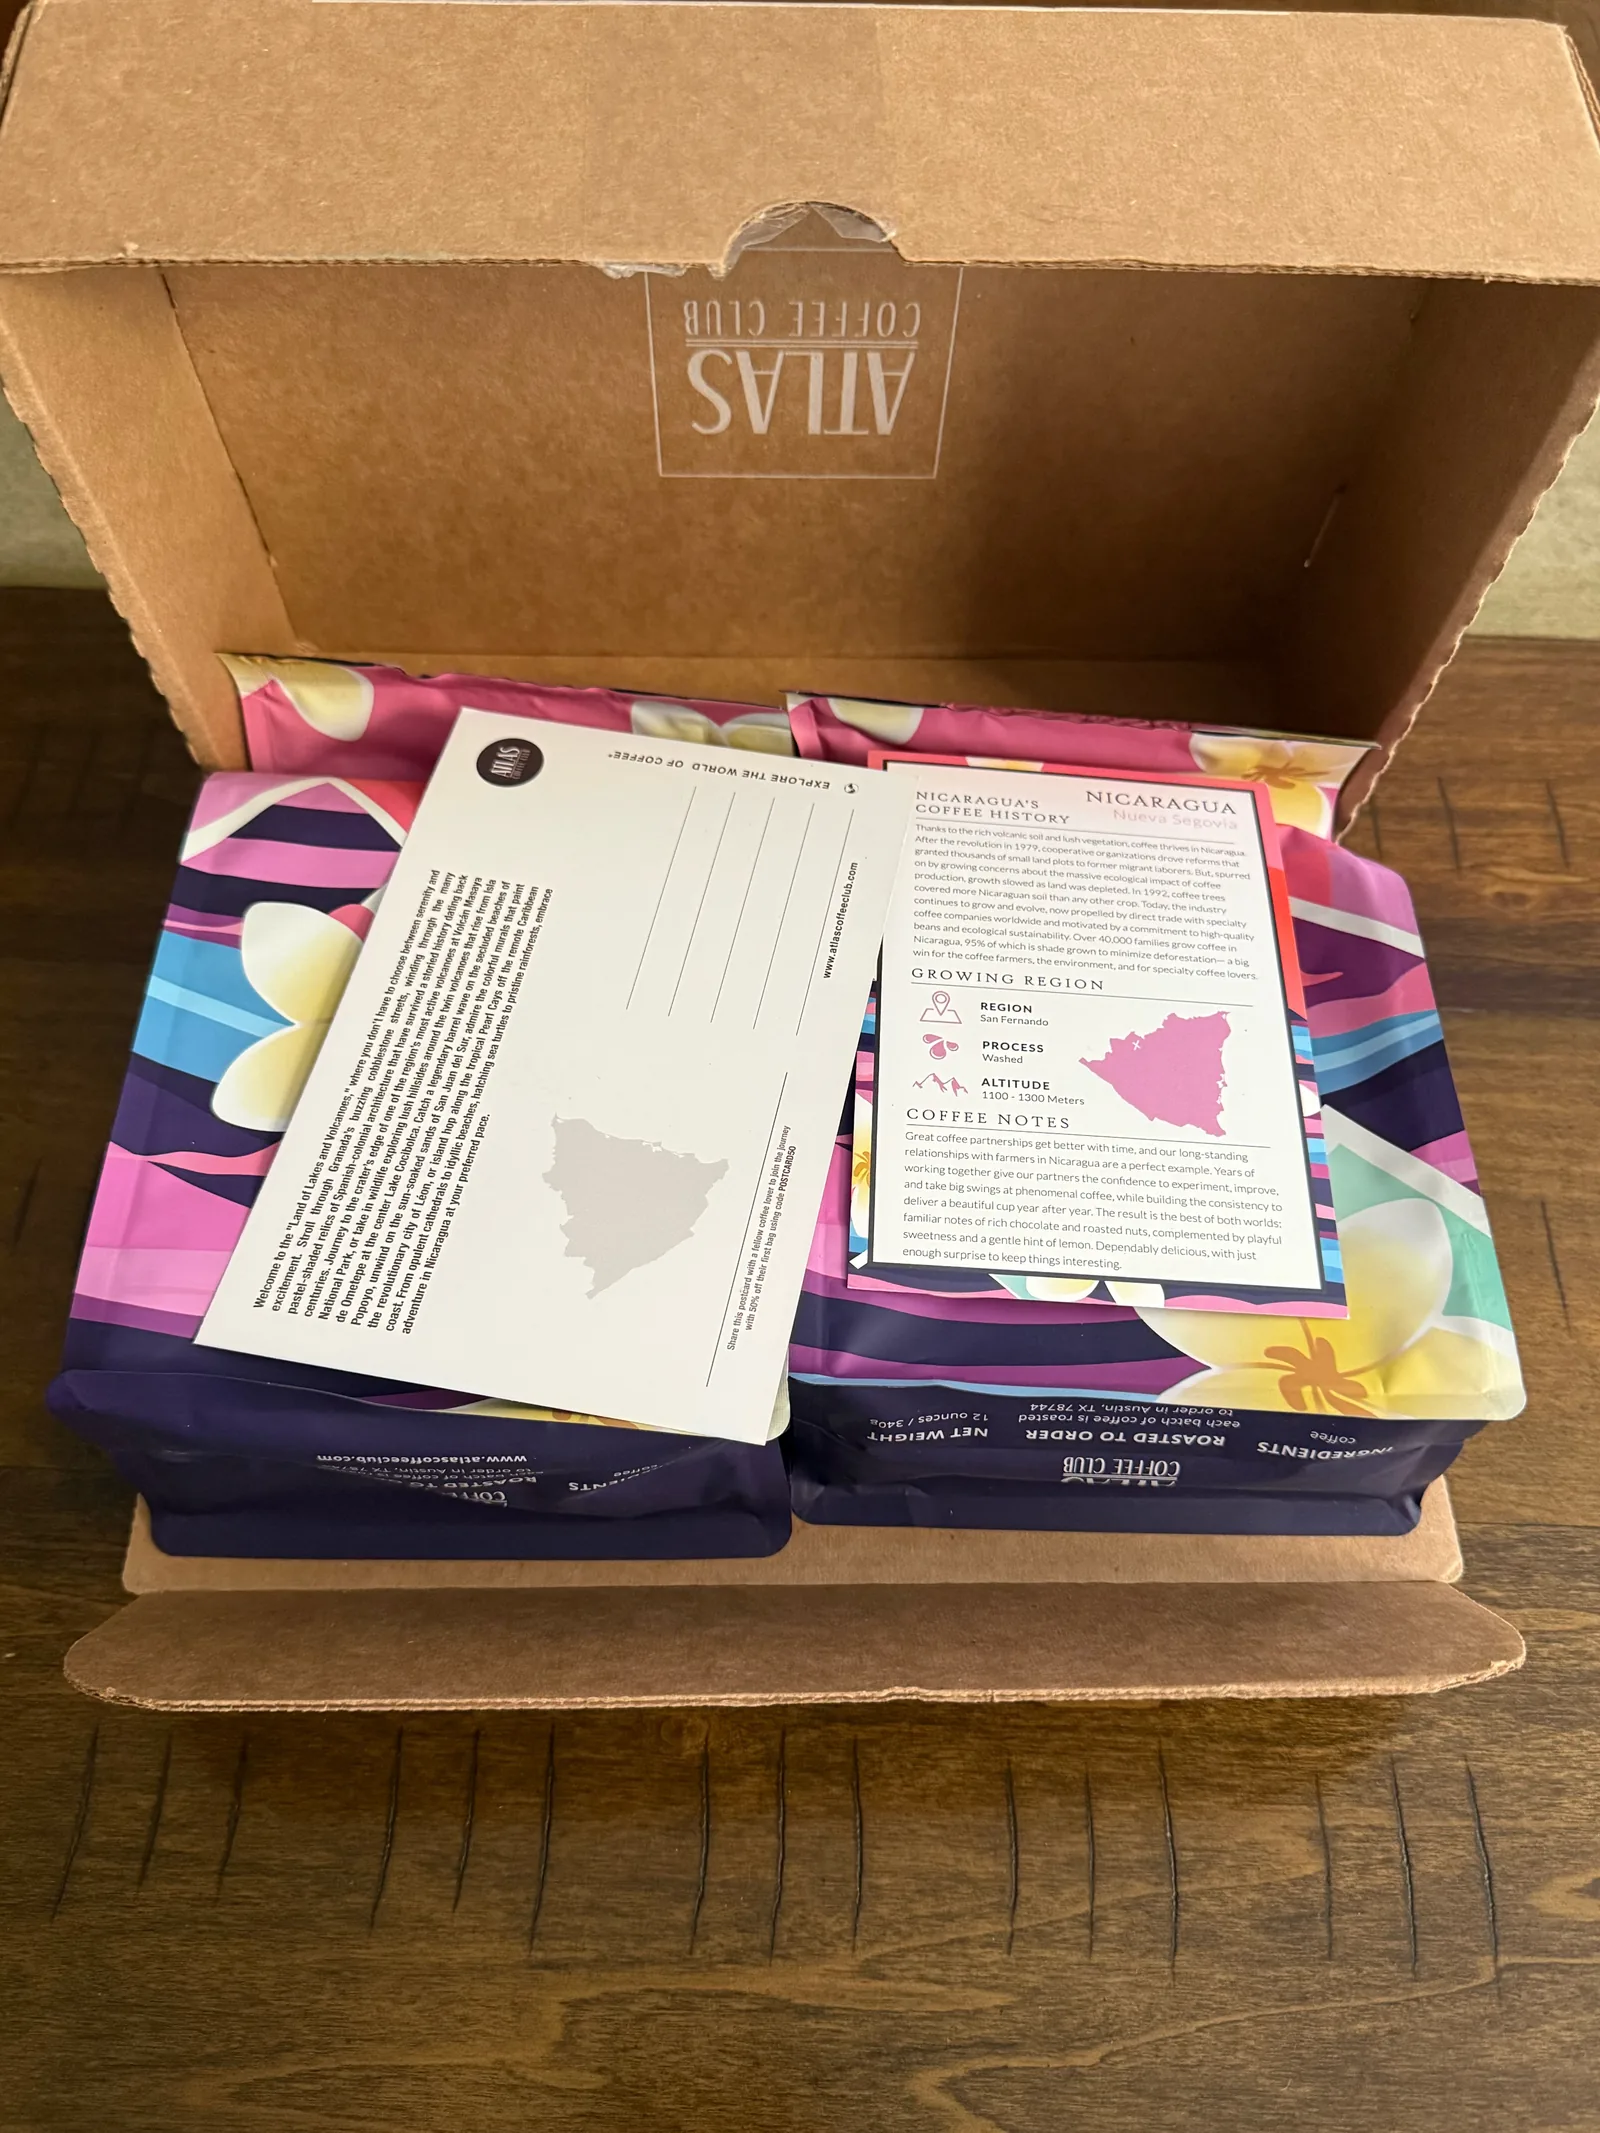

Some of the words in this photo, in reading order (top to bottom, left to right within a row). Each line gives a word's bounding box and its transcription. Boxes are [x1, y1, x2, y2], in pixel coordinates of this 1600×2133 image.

[684, 300, 765, 336] CLUB
[789, 301, 921, 338] COFFEE
[687, 349, 916, 435] ATLAS
[491, 746, 520, 778] ATLAS
[666, 759, 684, 768] OF
[692, 763, 738, 777] WORLD
[742, 770, 767, 781] THE
[771, 774, 830, 790] EXPLORE
[917, 791, 1038, 809] NICARAGUA'S
[1086, 791, 1236, 814] NICARAGUA
[916, 804, 982, 817] COFFEE
[991, 810, 1069, 824] HISTORY
[1113, 809, 1166, 823] Nueva
[1172, 814, 1237, 829] Segovia
[429, 869, 440, 885] and
[416, 886, 435, 918] serenity
[823, 862, 858, 978] www.atlascoffeeclub.com
[400, 920, 421, 954] between
[390, 955, 407, 985] choose
[948, 951, 963, 959] the
[965, 953, 994, 961] coffee
[996, 954, 1035, 964] farmers,
[1037, 957, 1052, 965] the
[1054, 959, 1116, 970] environment,
[1137, 964, 1151, 972] for
[1153, 967, 1194, 976] specialty
[1196, 969, 1225, 977] coffee
[1227, 971, 1257, 979] lovers.
[912, 968, 1013, 984] GROWING
[1024, 976, 1102, 990] REGION
[384, 986, 395, 994] to
[375, 997, 391, 1017] have
[981, 1002, 1031, 1013] REGION
[980, 1014, 998, 1023] San
[1001, 1016, 1048, 1026] Fernando
[367, 1018, 383, 1040] don't
[361, 1042, 373, 1057] you
[983, 1041, 1043, 1052] PROCESS
[982, 1054, 1023, 1063] Washed
[349, 1059, 366, 1086] where
[272, 1254, 302, 1311] excitement.
[296, 1221, 316, 1247] Stroll
[309, 1179, 334, 1214] through
[328, 1127, 355, 1172] Granada's
[349, 1086, 372, 1121] buzzing
[368, 1029, 394, 1081] cobblestone
[390, 993, 410, 1023] streets,
[405, 954, 424, 986] winding
[417, 917, 437, 948] through
[432, 899, 444, 912] the
[440, 872, 455, 894] many
[981, 1078, 1050, 1090] ALTITUDE
[982, 1091, 1008, 1100] 1100
[1019, 1093, 1044, 1102] 1300
[1048, 1095, 1084, 1105] Meters
[324, 1088, 353, 1140] Volcanoes,"
[907, 1108, 986, 1123] COFFEE
[998, 1114, 1068, 1128] NOTES
[475, 1114, 490, 1138] pace.
[777, 1125, 790, 1151] journey
[319, 1142, 332, 1160] and
[906, 1132, 934, 1141] Great
[936, 1134, 967, 1143] coffee
[970, 1137, 1033, 1148] partnerships
[1035, 1141, 1051, 1149] get
[1054, 1140, 1085, 1150] better
[1087, 1143, 1109, 1152] with
[1112, 1145, 1136, 1154] time,
[1139, 1147, 1157, 1155] and
[1179, 1149, 1248, 1163] long-standing
[458, 1139, 480, 1182] preferred
[774, 1152, 783, 1162] the
[304, 1162, 324, 1189] Lakes
[770, 1164, 780, 1178] join
[778, 1146, 796, 1191] POSTCARD50
[302, 1190, 312, 1200] of
[450, 1184, 463, 1205] your
[763, 1187, 774, 1204] lover
[775, 1193, 784, 1210] code
[286, 1202, 307, 1230] "Land
[446, 1207, 456, 1217] at
[759, 1206, 769, 1228] coffee
[770, 1211, 782, 1231] using
[279, 1234, 293, 1248] the
[424, 1220, 451, 1269] Nicaragua
[751, 1229, 763, 1251] fellow
[764, 1233, 776, 1246] bag
[273, 1251, 286, 1260] to
[761, 1247, 771, 1262] first
[903, 1248, 941, 1259] enough
[944, 1251, 986, 1260] surprise
[989, 1252, 999, 1261] to
[1002, 1252, 1026, 1264] keep
[1029, 1254, 1060, 1266] things
[1063, 1256, 1121, 1271] interesting.
[419, 1271, 432, 1280] in
[747, 1260, 756, 1275] with
[756, 1264, 767, 1281] their
[253, 1263, 281, 1307] Welcome
[754, 1283, 762, 1293] off
[739, 1277, 752, 1310] postcard
[402, 1283, 427, 1334] adventure
[749, 1296, 759, 1312] 50%
[733, 1312, 743, 1326] this
[745, 1314, 755, 1330] with
[727, 1328, 739, 1350] Share
[1030, 1403, 1075, 1412] 78744
[1078, 1404, 1096, 1413] TX
[1101, 1404, 1151, 1415] Austin,
[1156, 1405, 1169, 1415] in
[1172, 1407, 1214, 1417] order
[1218, 1409, 1234, 1417] to
[918, 1412, 968, 1424] ounces
[972, 1412, 989, 1422] 12
[1019, 1413, 1073, 1424] roasted
[1077, 1414, 1089, 1423] is
[1093, 1414, 1138, 1427] coffee
[1140, 1416, 1157, 1427] of
[1161, 1417, 1201, 1428] batch
[1206, 1419, 1241, 1428] each
[866, 1430, 944, 1442] WEIGHT
[950, 1427, 989, 1438] NET
[1025, 1429, 1094, 1442] ORDER
[1100, 1431, 1126, 1443] TO
[1133, 1431, 1226, 1446] ROASTED
[1310, 1430, 1357, 1445] coffee
[316, 1454, 528, 1465] www.atlascoffeeclub.com
[1063, 1456, 1107, 1475] CLUB
[1113, 1457, 1182, 1477] COFFEE
[444, 1475, 538, 1489] ROASTED
